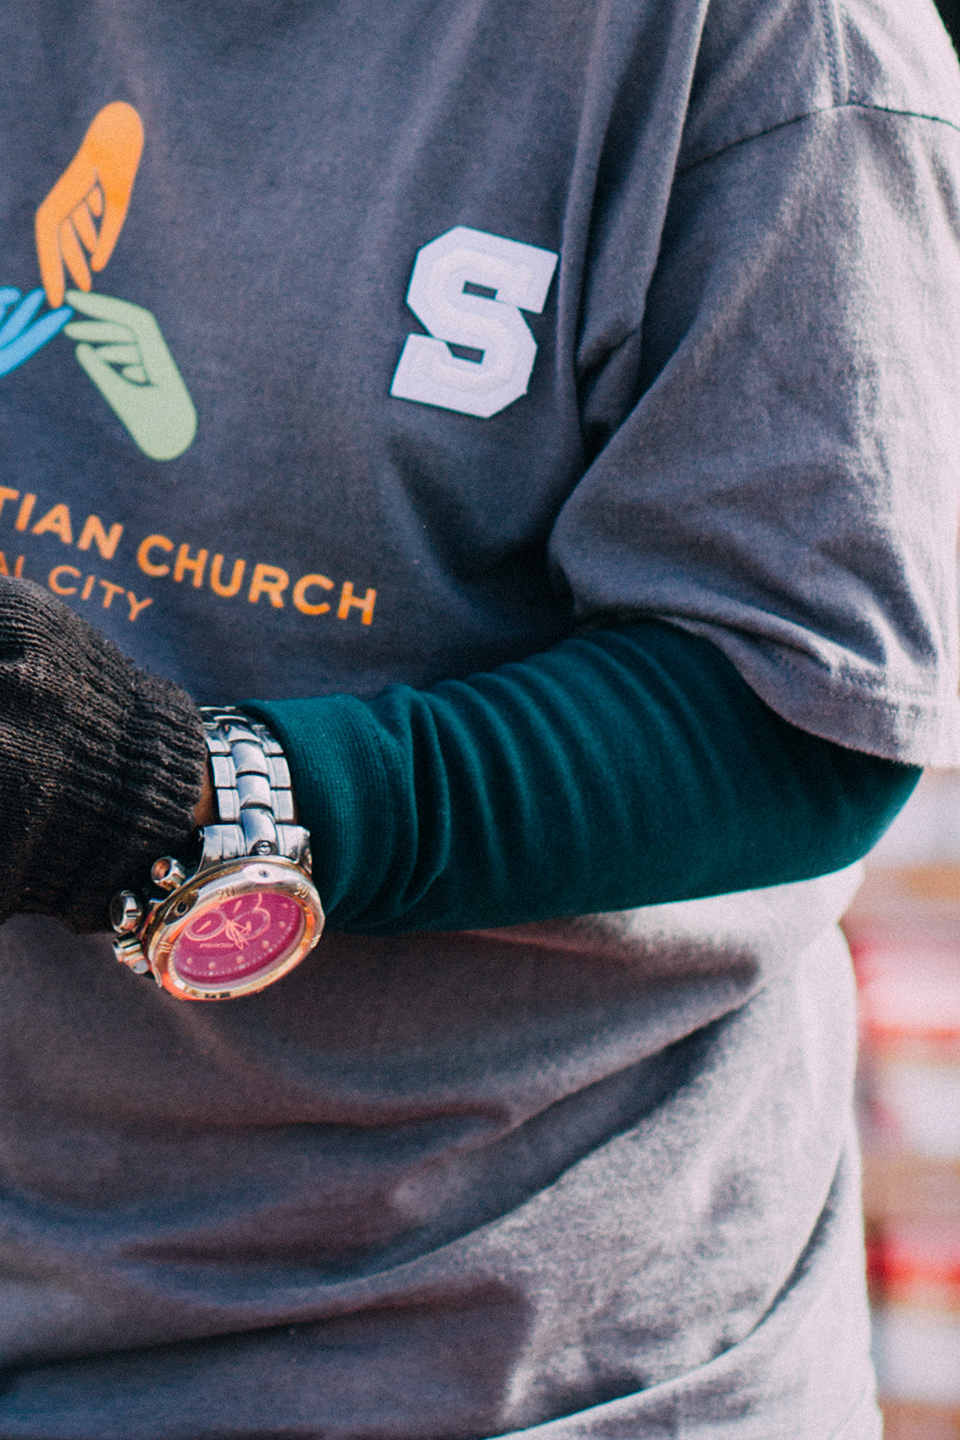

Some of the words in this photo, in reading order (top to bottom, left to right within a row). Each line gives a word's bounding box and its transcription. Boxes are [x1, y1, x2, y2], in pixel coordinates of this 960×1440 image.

[390, 224, 560, 419] S
[48, 565, 154, 622] CITY
[136, 534, 377, 626] CHURCH
